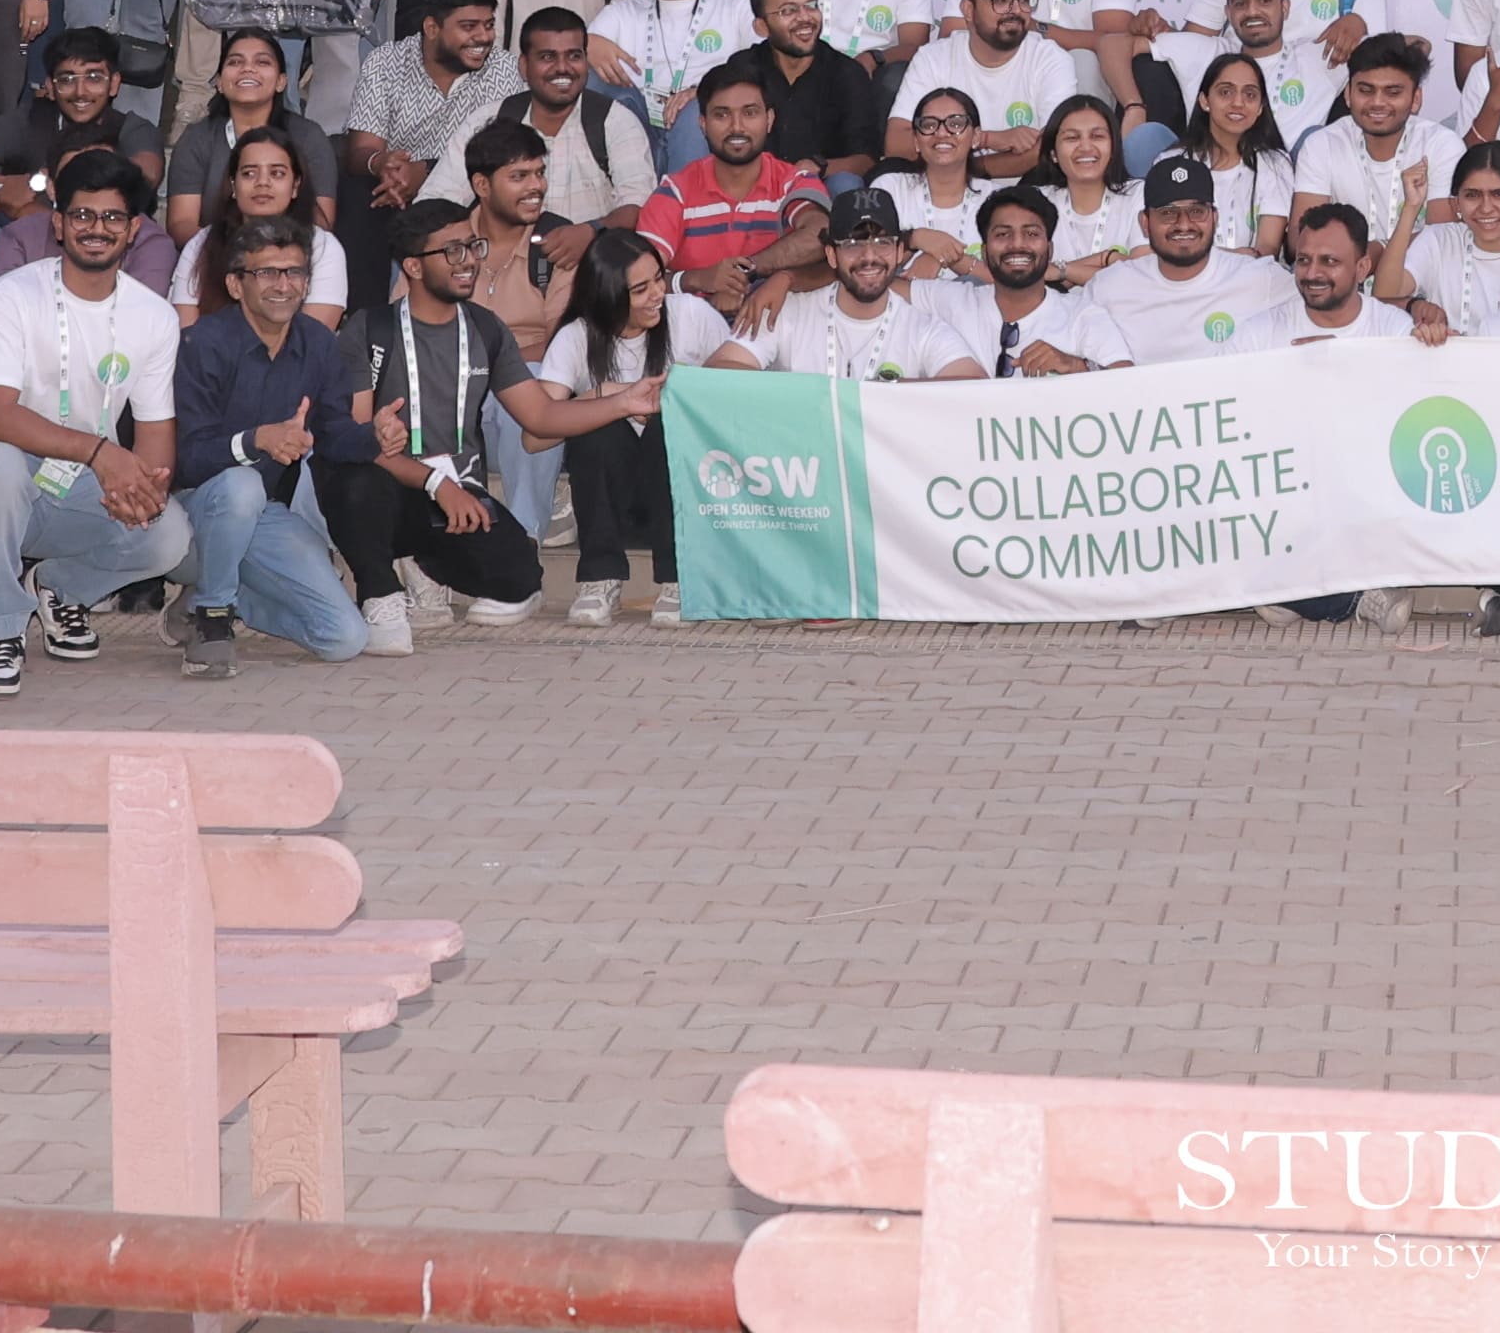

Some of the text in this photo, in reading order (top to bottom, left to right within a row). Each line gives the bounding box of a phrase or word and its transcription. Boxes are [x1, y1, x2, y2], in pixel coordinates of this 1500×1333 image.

[976, 397, 1252, 463] INNOVATE.
[698, 450, 820, 498] OSW
[926, 448, 1310, 522] COLLABORATE.
[1436, 445, 1453, 512] OPEN
[699, 503, 830, 519] OPEN SOURCE WEEKEND
[952, 510, 1294, 580] COMMUNITY.
